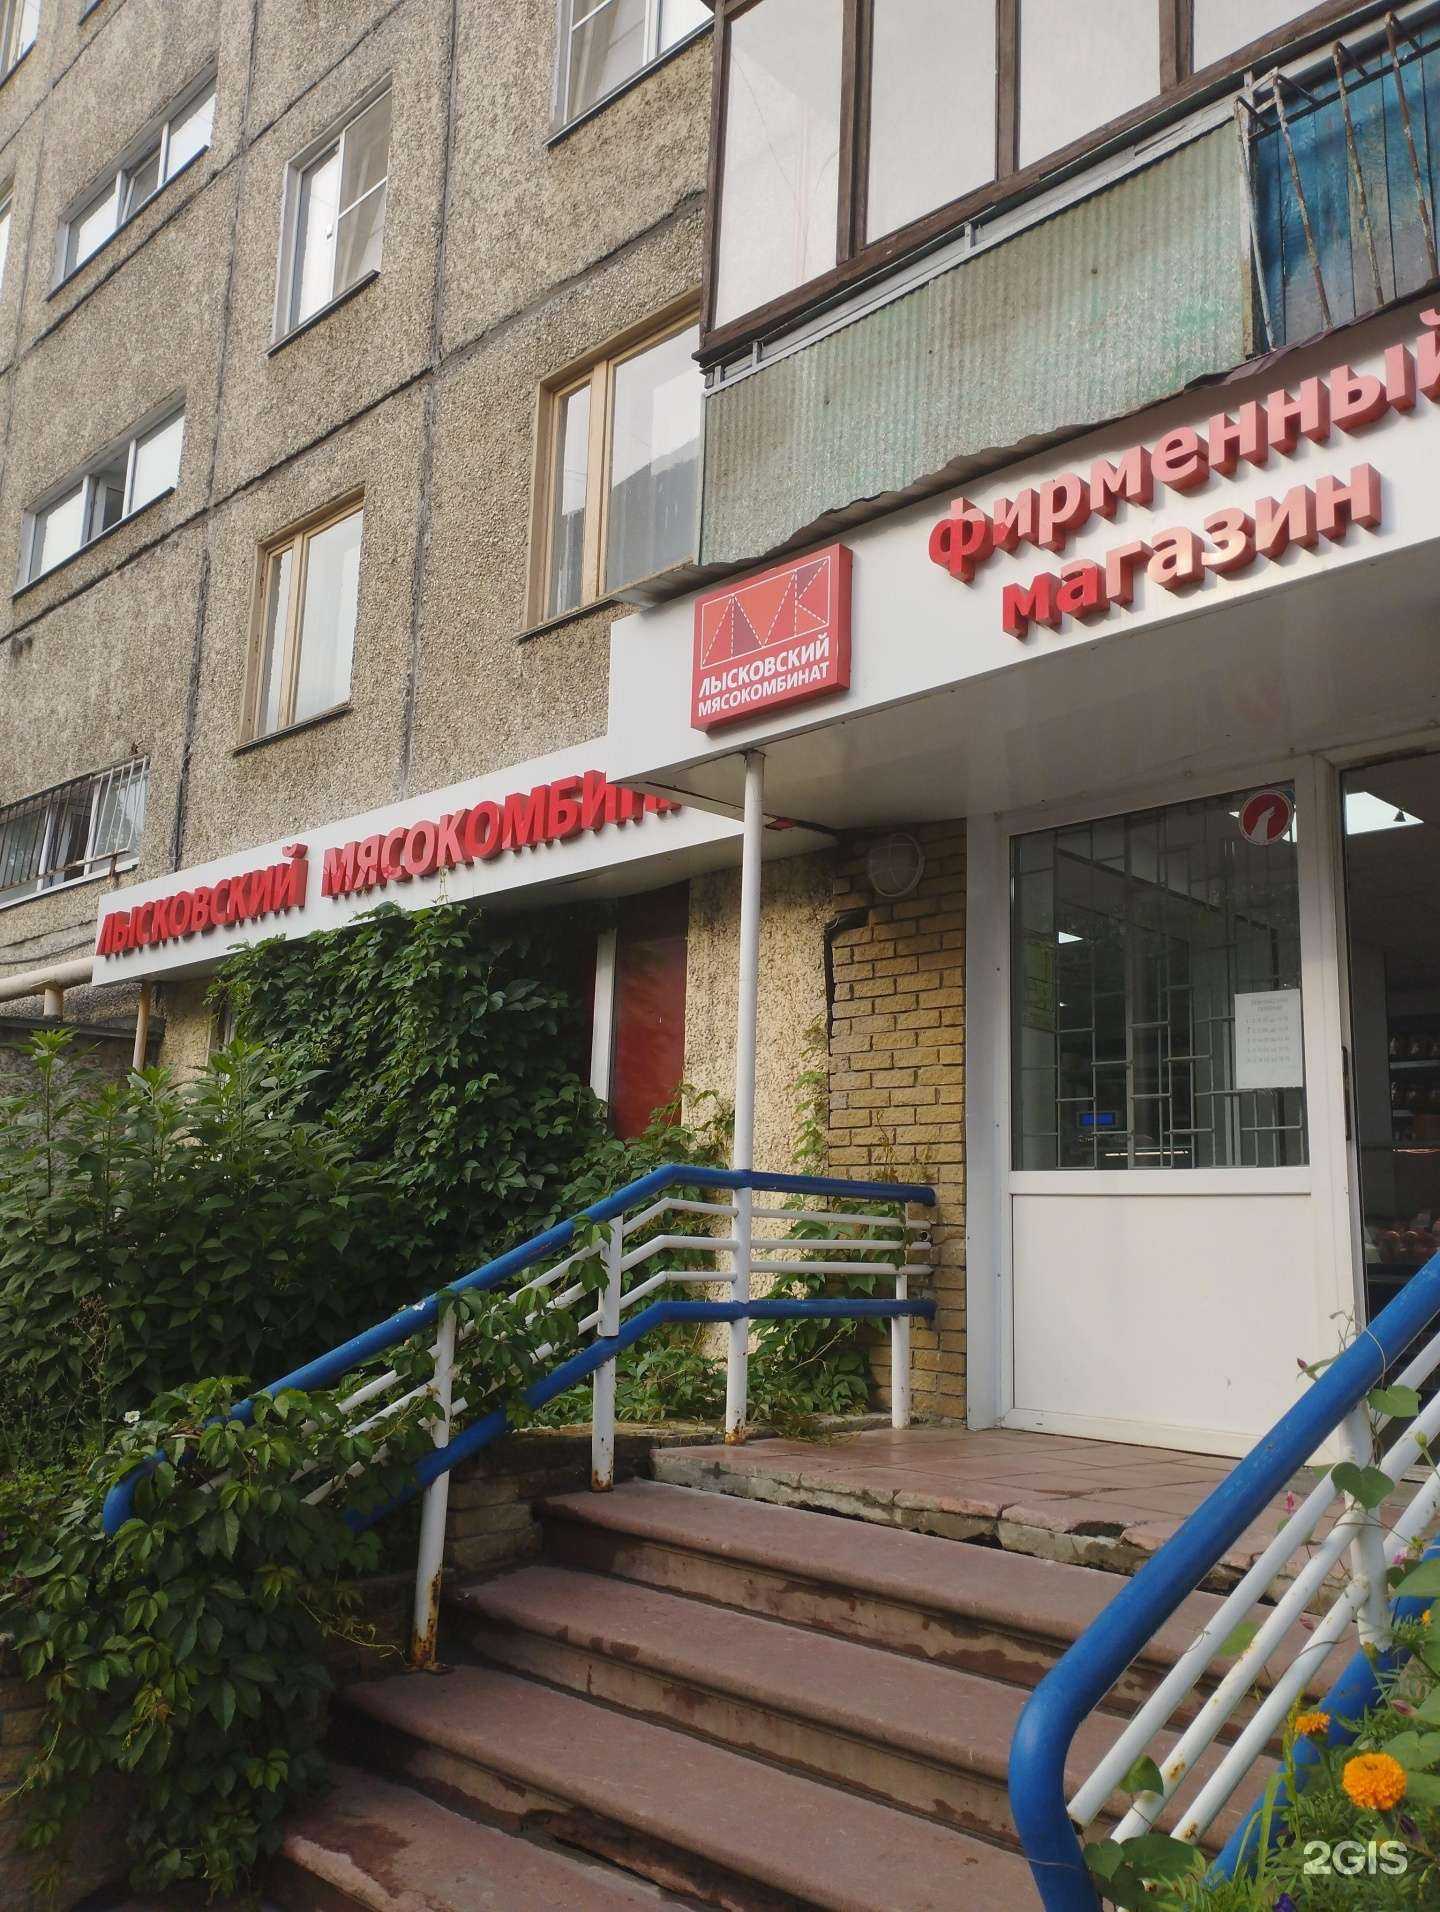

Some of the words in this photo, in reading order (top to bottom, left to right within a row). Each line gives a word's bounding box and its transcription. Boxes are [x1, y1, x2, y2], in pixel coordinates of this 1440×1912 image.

[1002, 462, 1382, 638] магазин
[698, 632, 831, 699] ЛЫСКОВСКИЙ
[698, 661, 830, 717] МЯСОКОМБИНАТ
[96, 842, 309, 957] ЛЫСКОВСКИЙ
[321, 769, 682, 898] МЯСОКОМБИ
